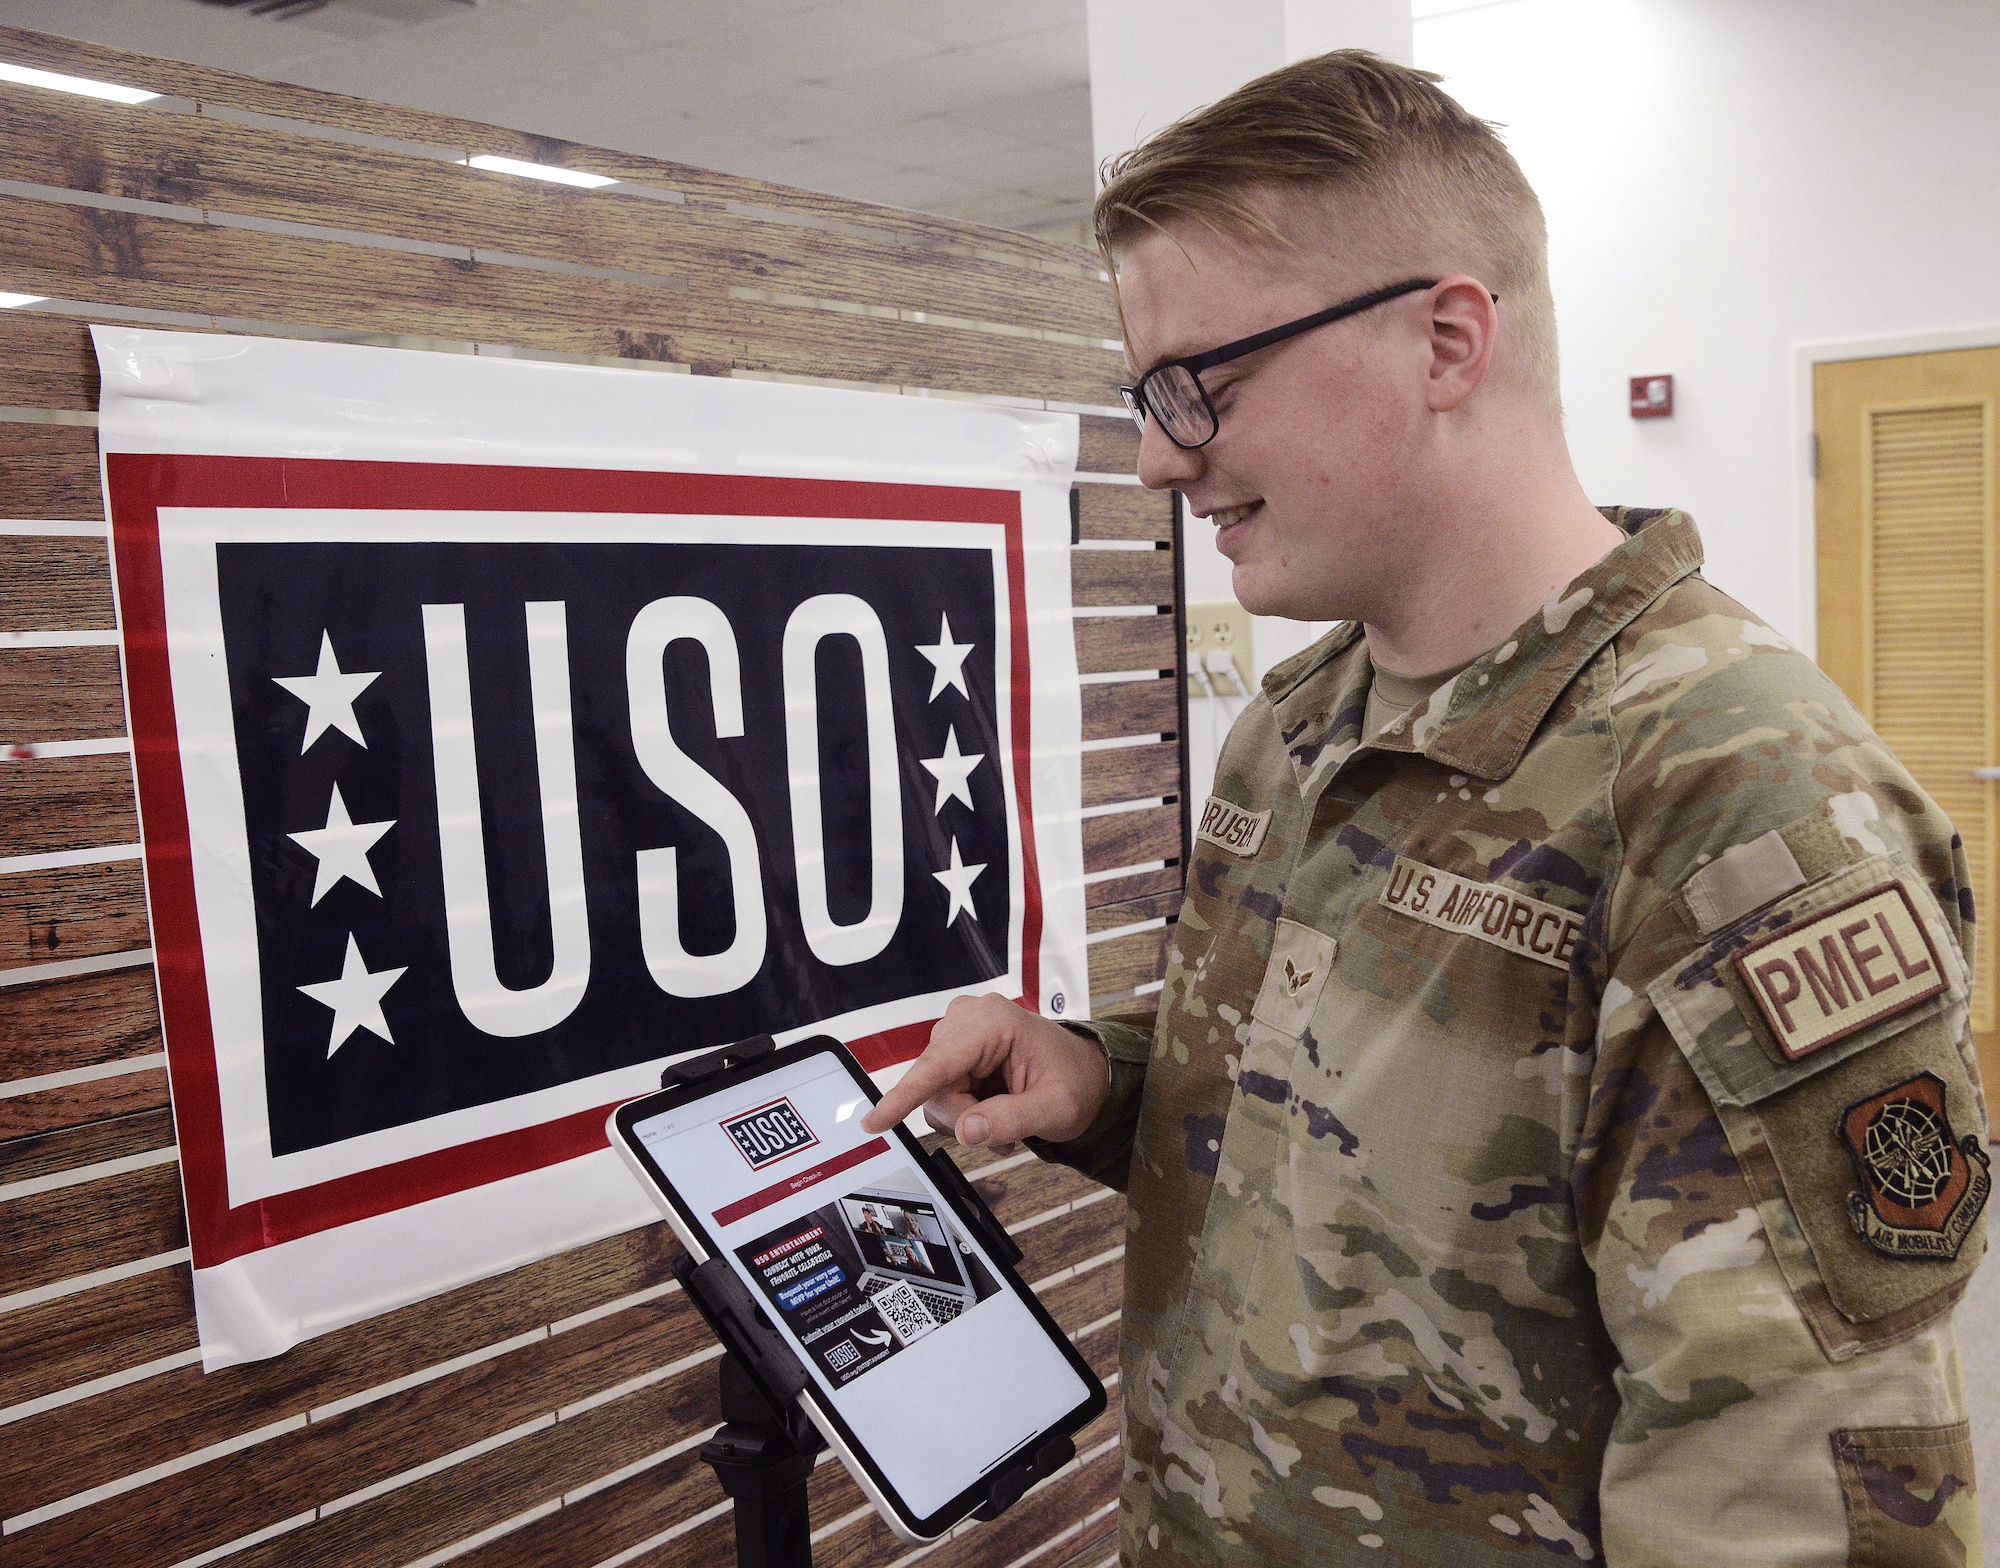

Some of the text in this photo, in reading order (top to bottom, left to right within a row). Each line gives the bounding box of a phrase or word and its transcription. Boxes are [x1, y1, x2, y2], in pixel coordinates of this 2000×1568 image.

[421, 593, 904, 1038] USO
[1386, 864, 1582, 963] U.S. AIR FORCE
[1754, 911, 1931, 1034] PMEL
[741, 1111, 799, 1156] USO
[790, 1179, 805, 1189] Begin
[1872, 1176, 1986, 1251] AIR MOBILITY COMMAND
[754, 1228, 823, 1266] USO ENTERTAINMENT
[763, 1243, 822, 1277] CONNECT WITH YOUR
[770, 1250, 833, 1287] FAVORITE CELEBRITIES
[779, 1266, 840, 1300] Request your very own
[790, 1293, 806, 1306] MVP
[804, 1288, 815, 1299] for
[813, 1283, 828, 1296] your
[801, 1327, 824, 1344] Submit
[820, 1321, 836, 1334] your
[832, 1310, 855, 1326] request
[831, 1344, 854, 1366] USO
